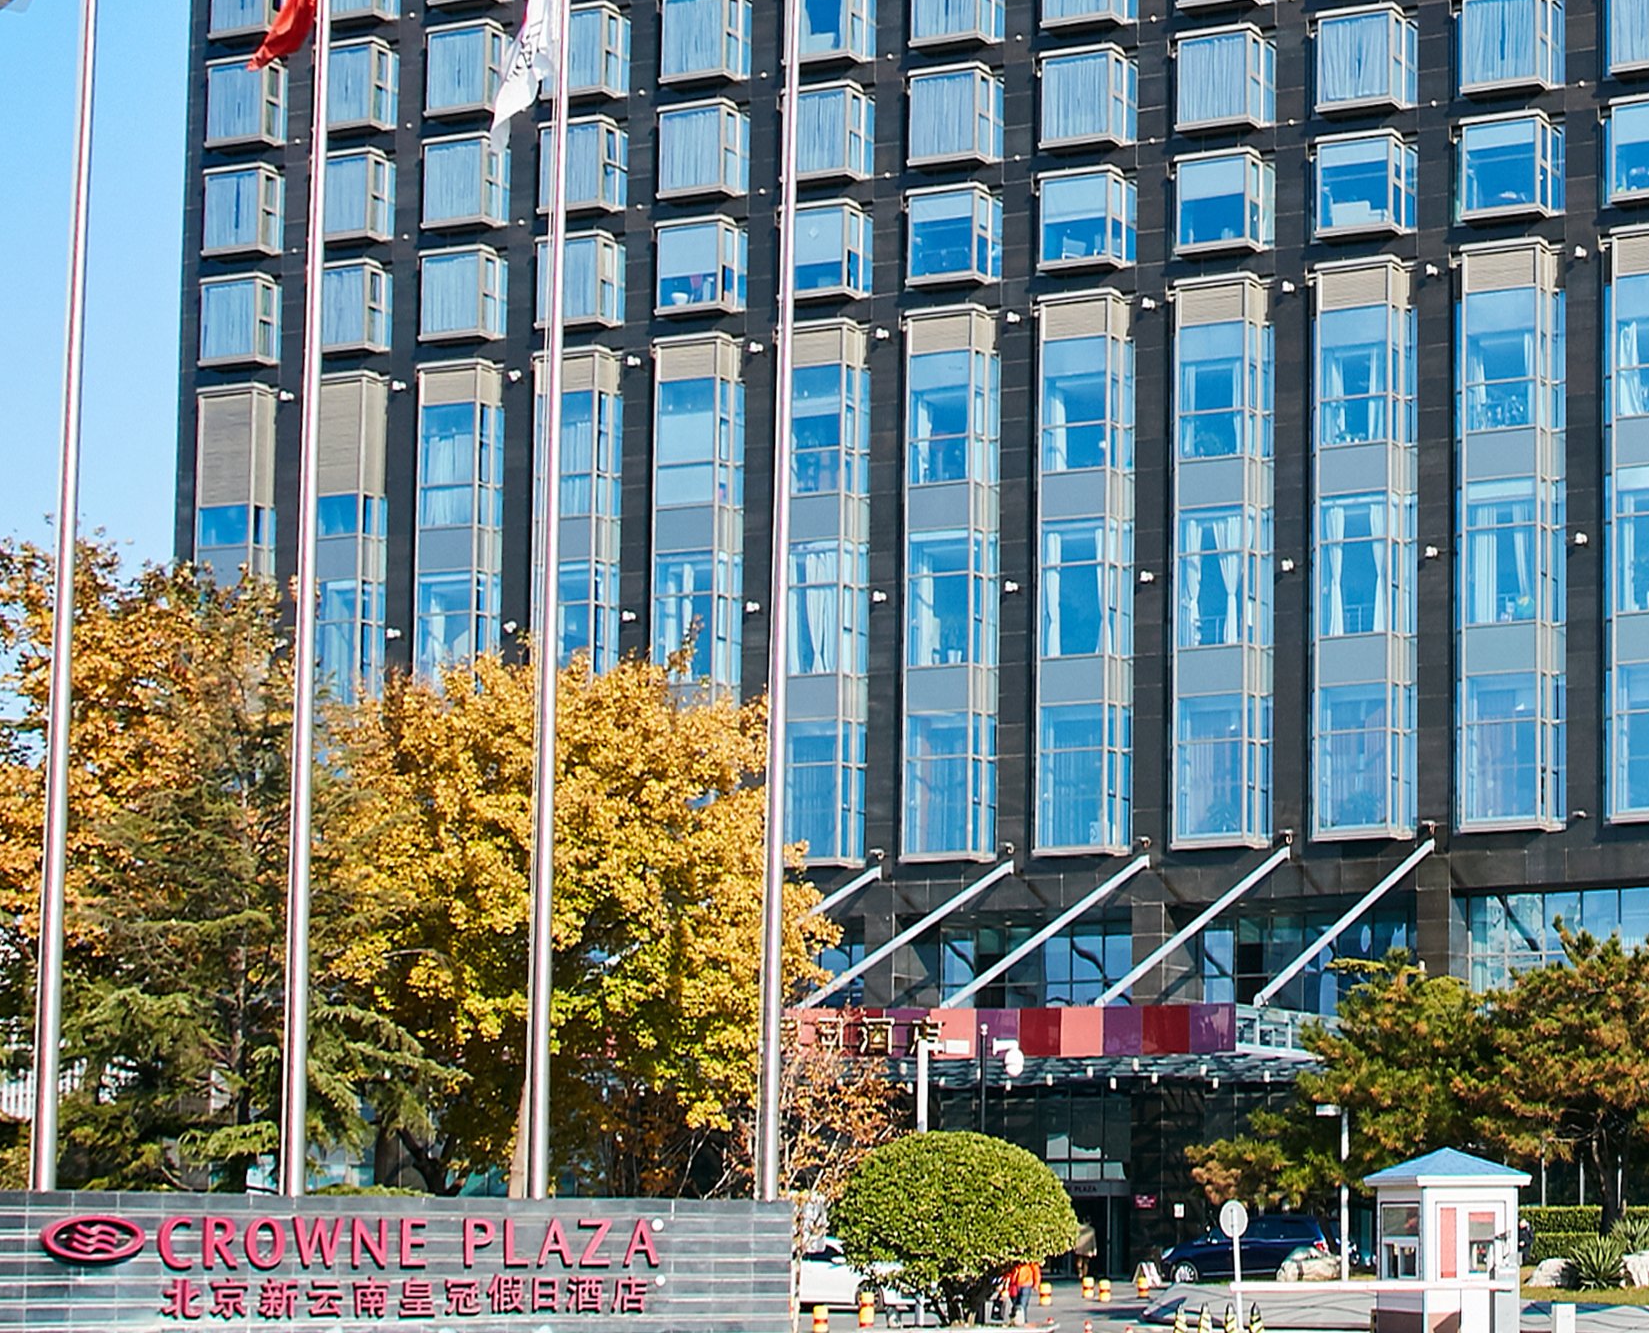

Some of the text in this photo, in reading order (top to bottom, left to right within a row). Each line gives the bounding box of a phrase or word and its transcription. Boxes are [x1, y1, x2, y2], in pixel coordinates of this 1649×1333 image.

[158, 1216, 660, 1269] CROWNE PLAZA
[159, 1274, 649, 1319] 北京新云南皇冠假日酒店
